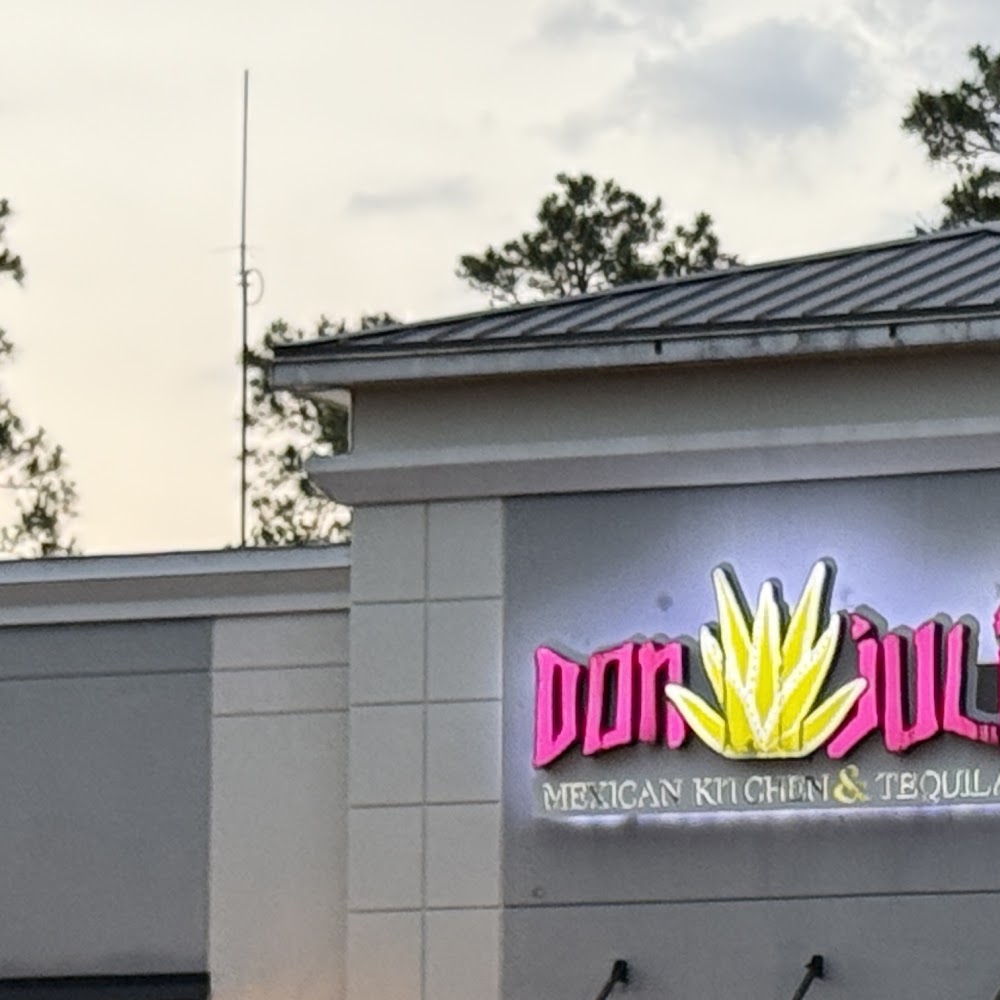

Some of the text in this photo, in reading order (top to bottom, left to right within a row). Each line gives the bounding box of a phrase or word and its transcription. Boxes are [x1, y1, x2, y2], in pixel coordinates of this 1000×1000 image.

[543, 778, 683, 811] MEXICAN
[692, 773, 830, 807] KITCHEN
[832, 763, 870, 804] &
